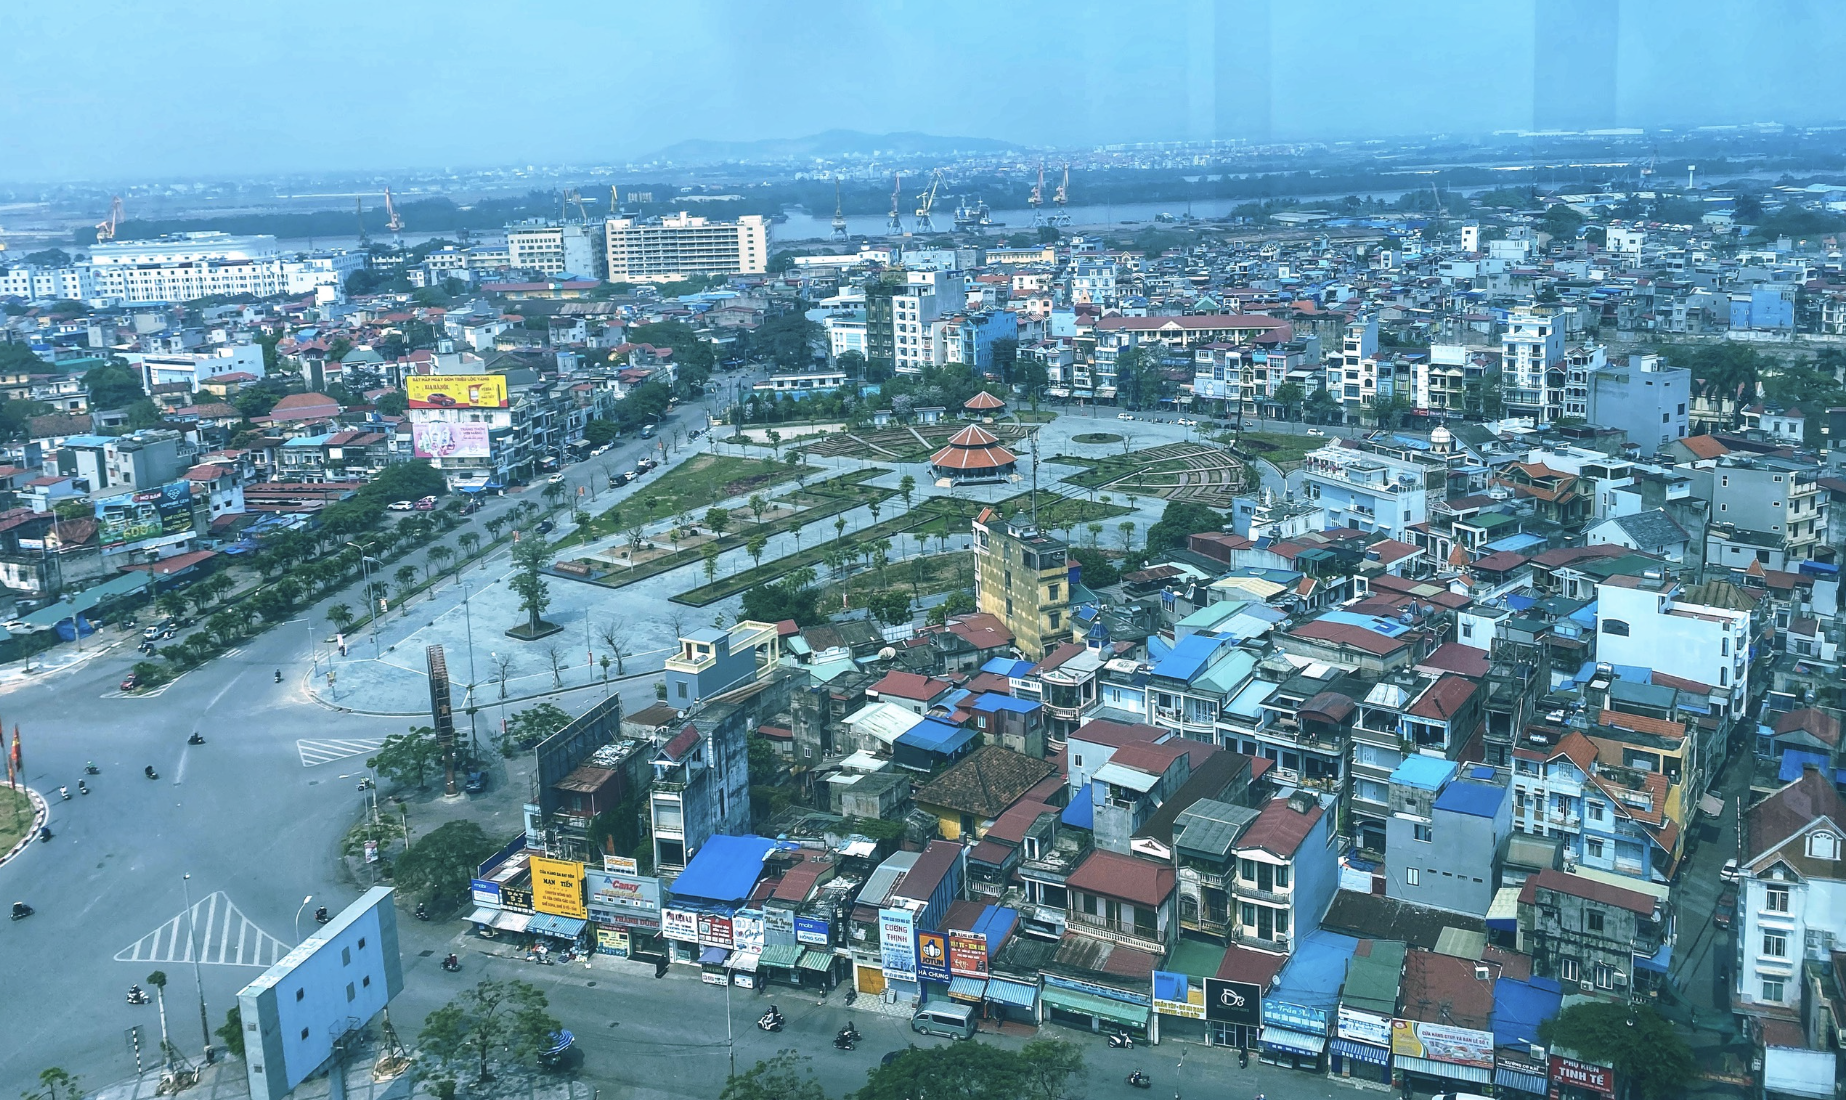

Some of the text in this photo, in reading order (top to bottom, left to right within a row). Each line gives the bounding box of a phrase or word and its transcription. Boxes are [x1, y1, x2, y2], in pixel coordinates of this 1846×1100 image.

[922, 956, 944, 965] JOTUN
[928, 971, 949, 980] CHUNG
[1563, 1059, 1600, 1073] PHỤ KIỆN
[1558, 1067, 1587, 1081] TINH
[1589, 1073, 1604, 1086] TẾ
